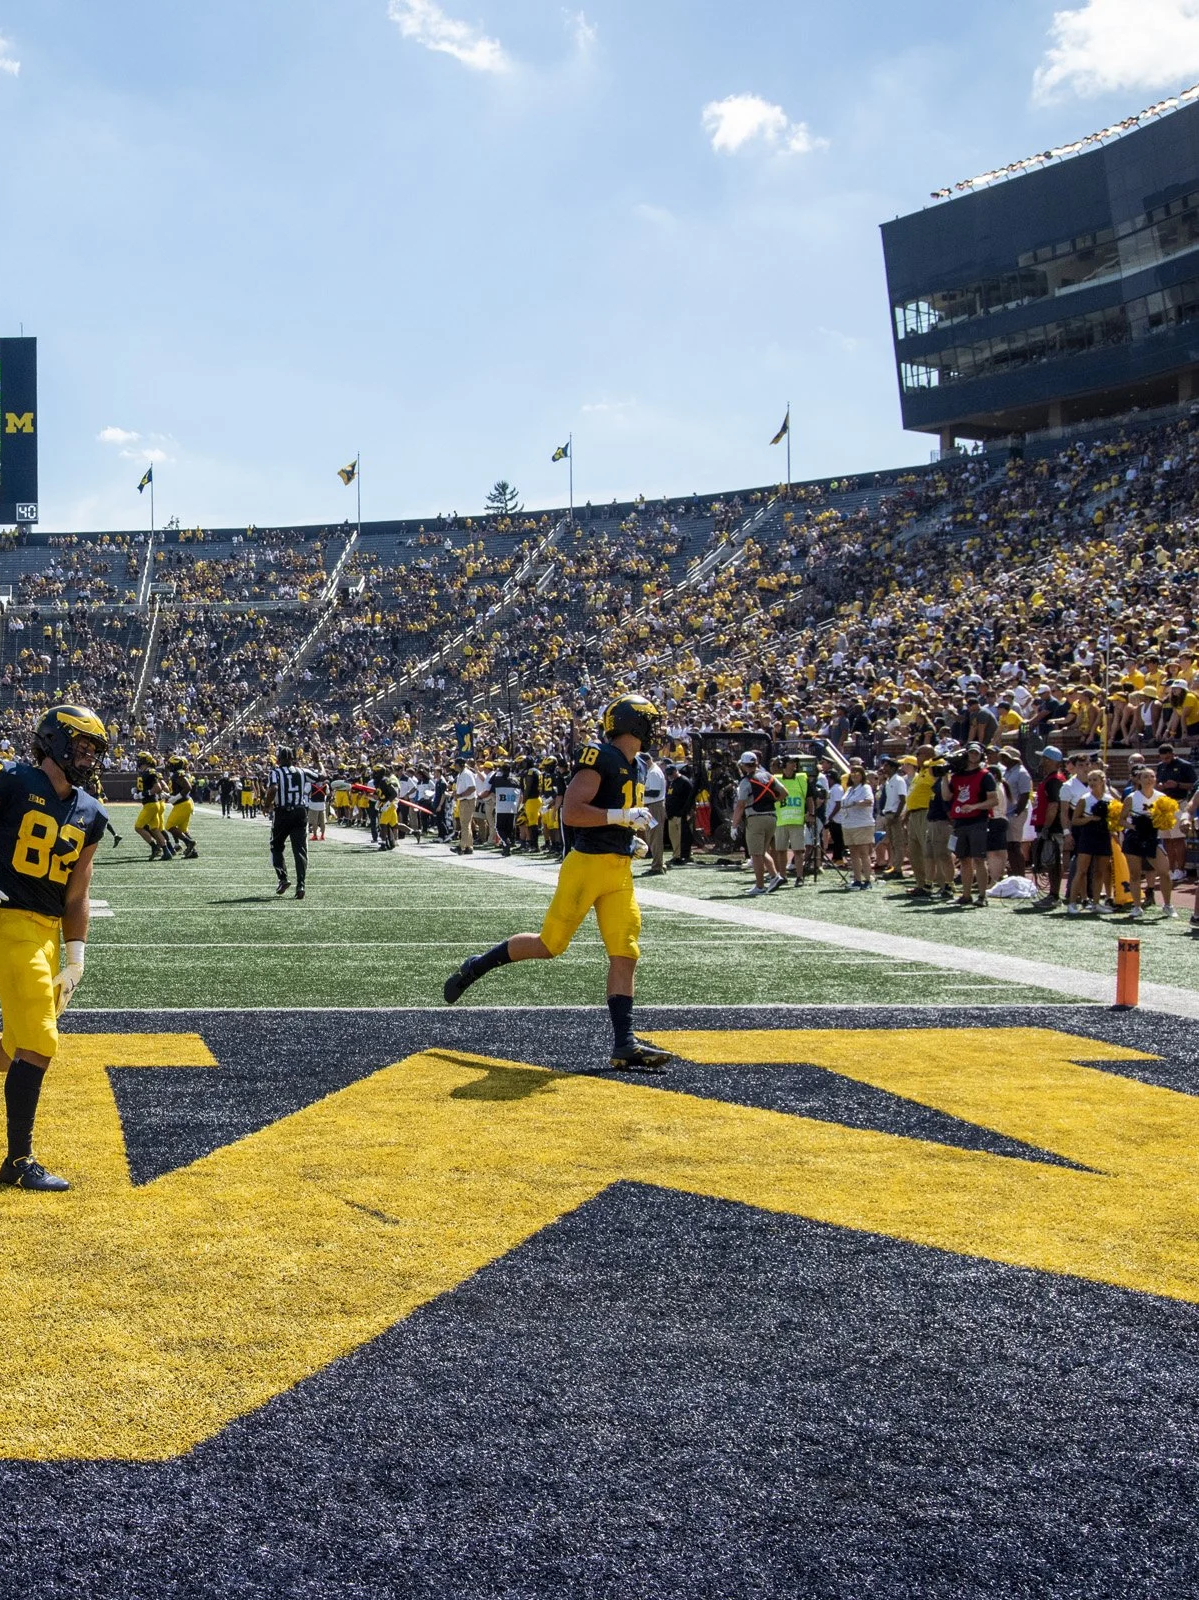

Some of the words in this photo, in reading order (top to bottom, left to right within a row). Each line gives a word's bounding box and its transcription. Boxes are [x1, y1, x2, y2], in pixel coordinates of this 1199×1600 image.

[5, 412, 34, 434] M
[18, 505, 37, 519] 40
[579, 747, 600, 765] 18
[12, 809, 86, 886] 82
